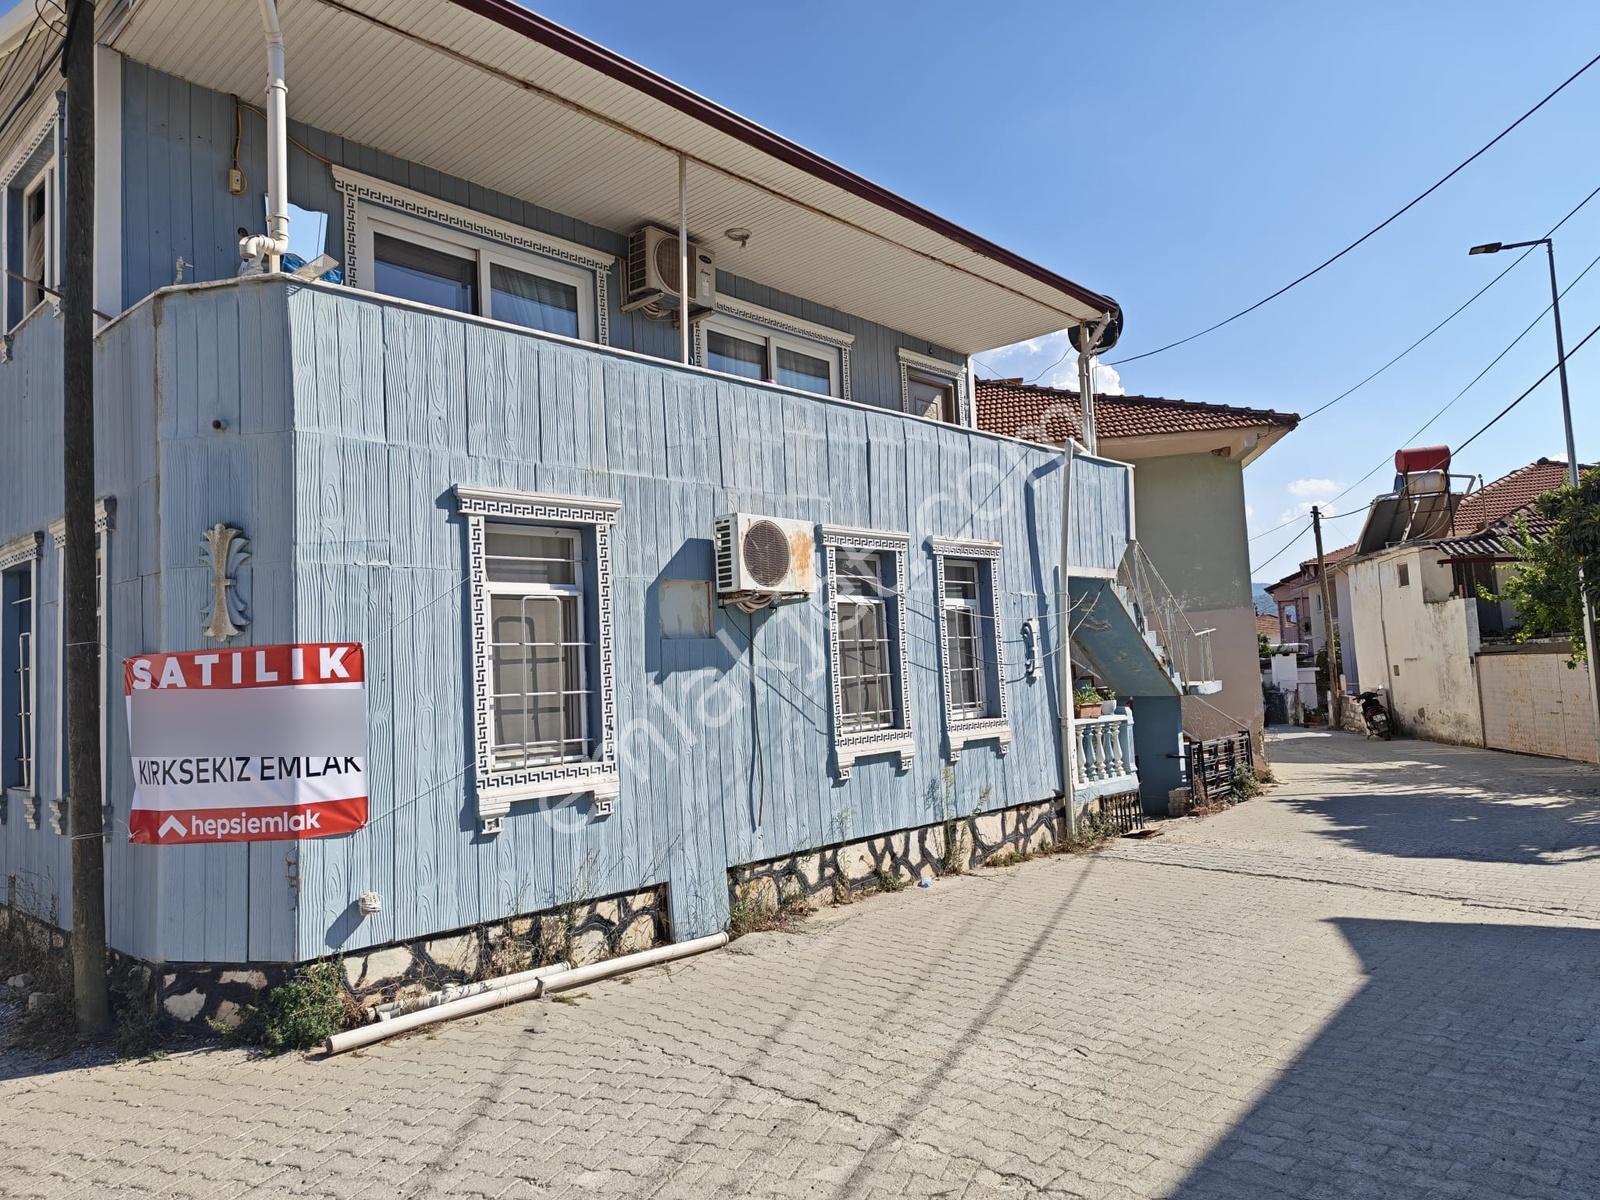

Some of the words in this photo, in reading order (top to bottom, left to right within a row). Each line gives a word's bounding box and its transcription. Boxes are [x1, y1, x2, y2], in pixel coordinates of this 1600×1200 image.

[132, 647, 350, 689] SATILIK
[260, 757, 361, 781] EMLAK
[191, 809, 321, 838] hepsiemlak
